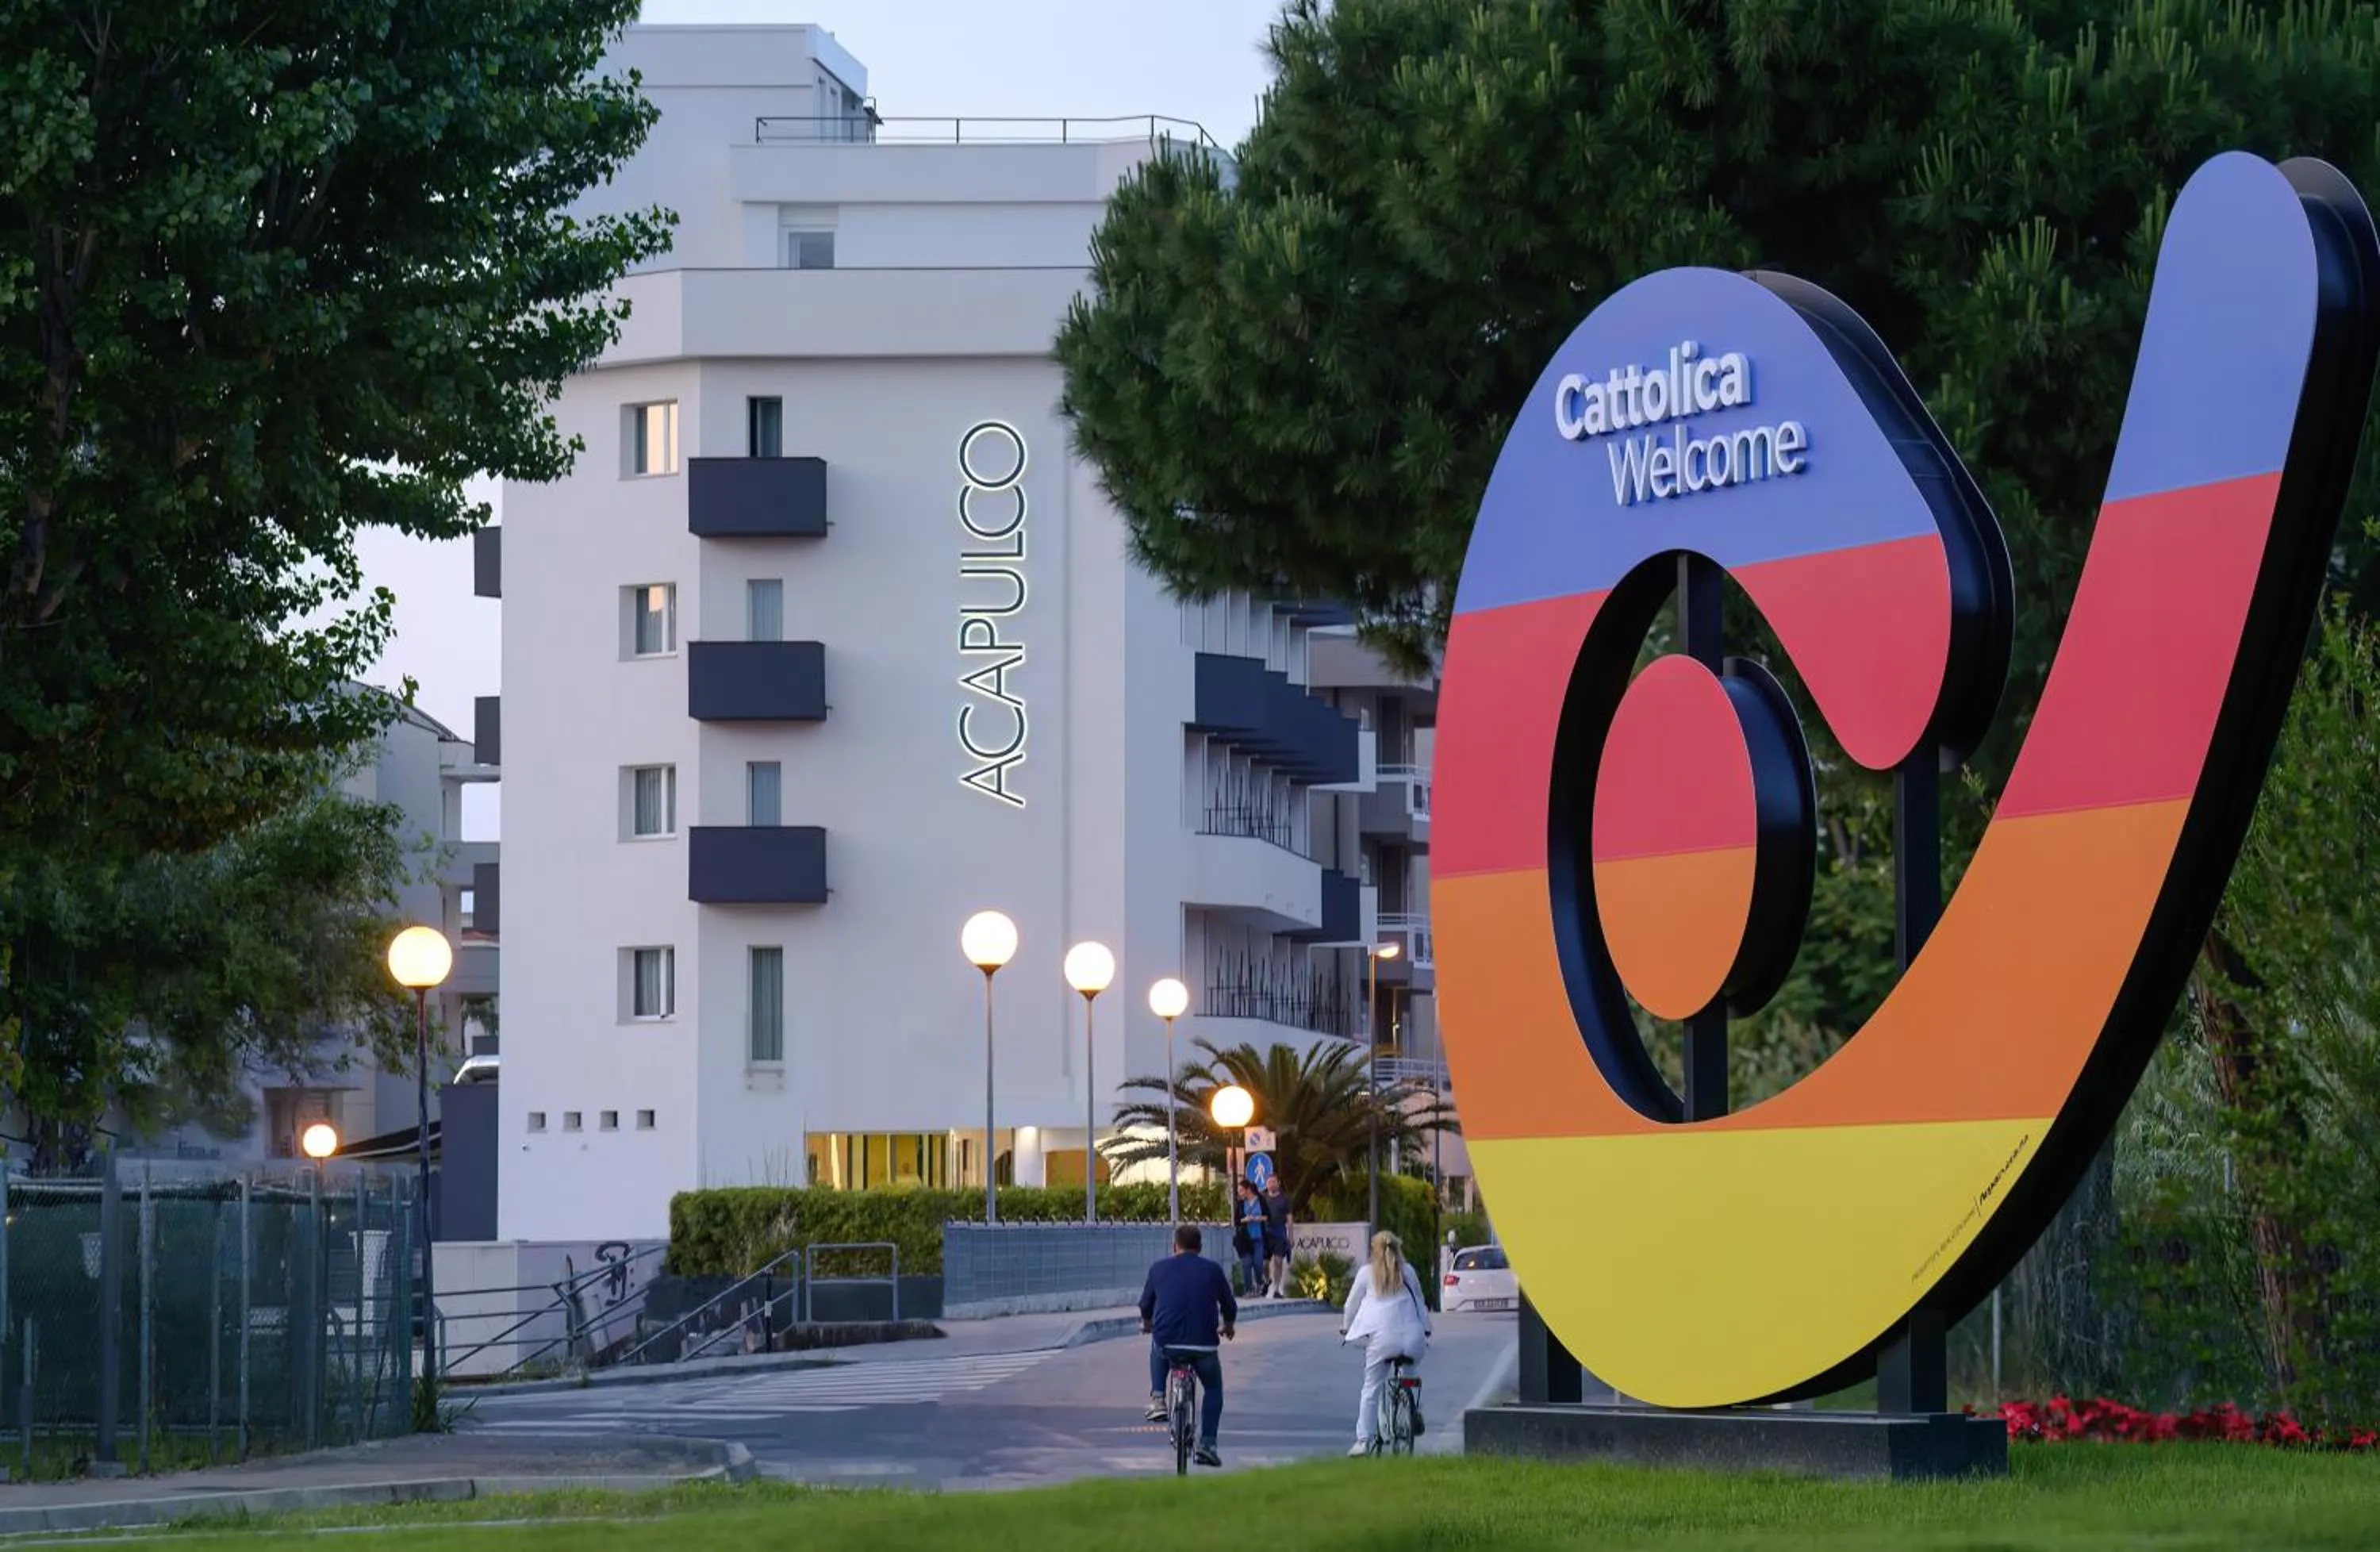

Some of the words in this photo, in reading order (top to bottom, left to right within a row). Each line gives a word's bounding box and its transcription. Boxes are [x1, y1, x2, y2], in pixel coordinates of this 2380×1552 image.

[1555, 340, 1750, 440] Cattolica
[1607, 422, 1808, 506] Welcome
[958, 420, 1027, 807] ACAPULCO
